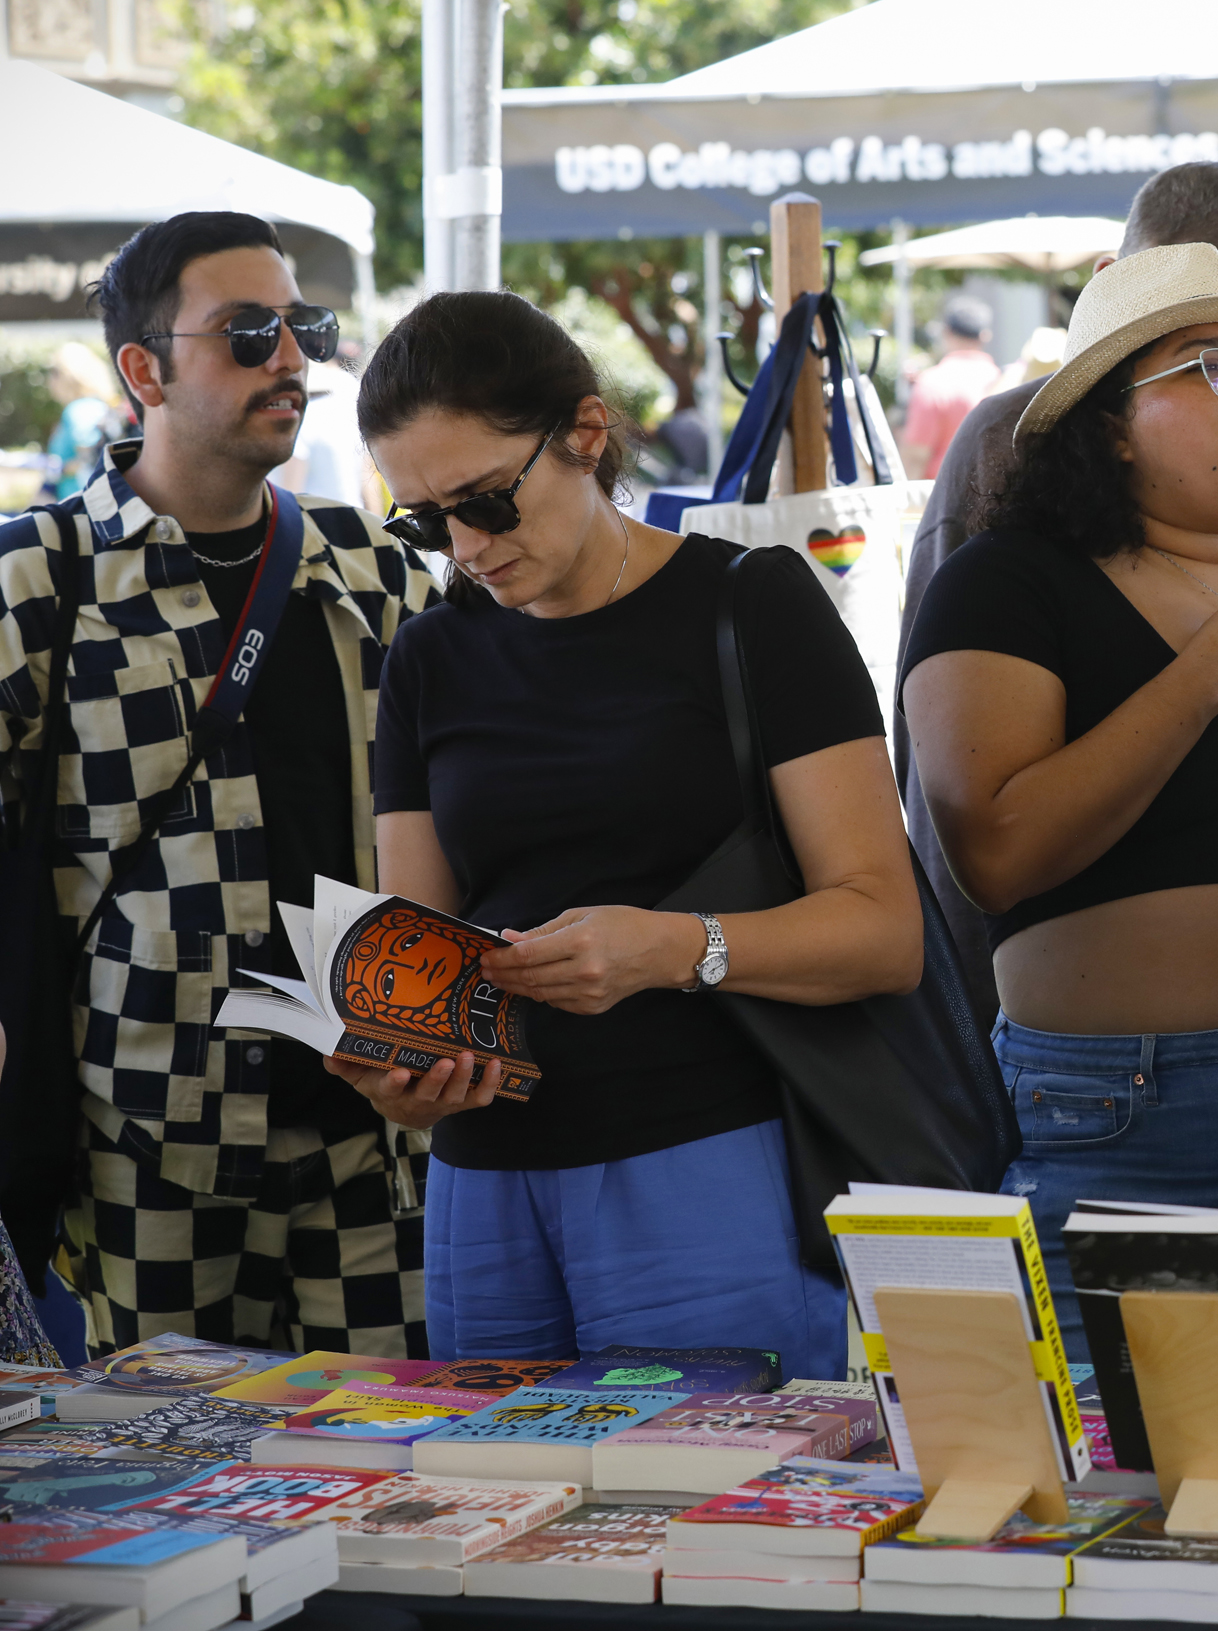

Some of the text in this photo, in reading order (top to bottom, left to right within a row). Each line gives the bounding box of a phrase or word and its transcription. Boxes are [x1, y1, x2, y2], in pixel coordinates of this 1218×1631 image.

[555, 145, 646, 190] USD
[648, 141, 802, 194] College
[803, 136, 855, 185] of
[855, 134, 949, 183] Arts
[951, 129, 1033, 178] and
[231, 628, 265, 687] EOS
[454, 977, 466, 994] YORK
[470, 982, 499, 1049] CIR
[354, 1039, 390, 1058] CIRCE
[398, 1050, 437, 1070] MADEL
[1021, 1217, 1080, 1434] THE VIXEN FRANCINE PROSE
[363, 1384, 489, 1401] NATSUKO IMAMURA
[702, 1393, 845, 1411] STOP
[365, 1401, 428, 1410] Woman
[664, 1425, 778, 1439] ONE
[812, 1418, 867, 1459] ONE LAST STOP
[2, 1444, 98, 1453] ORNING
[109, 1434, 234, 1462] CHOUETTE
[294, 1471, 357, 1481] JASON
[186, 1475, 364, 1498] BOOK
[153, 1494, 316, 1520] HELL
[500, 1517, 523, 1535] HEIGHTS
[525, 1510, 545, 1530] JOSHUA
[545, 1499, 564, 1520] HENKIN
[337, 1519, 483, 1537] MORNINGS
[549, 1522, 667, 1534] organ
[587, 1512, 671, 1524] kins
